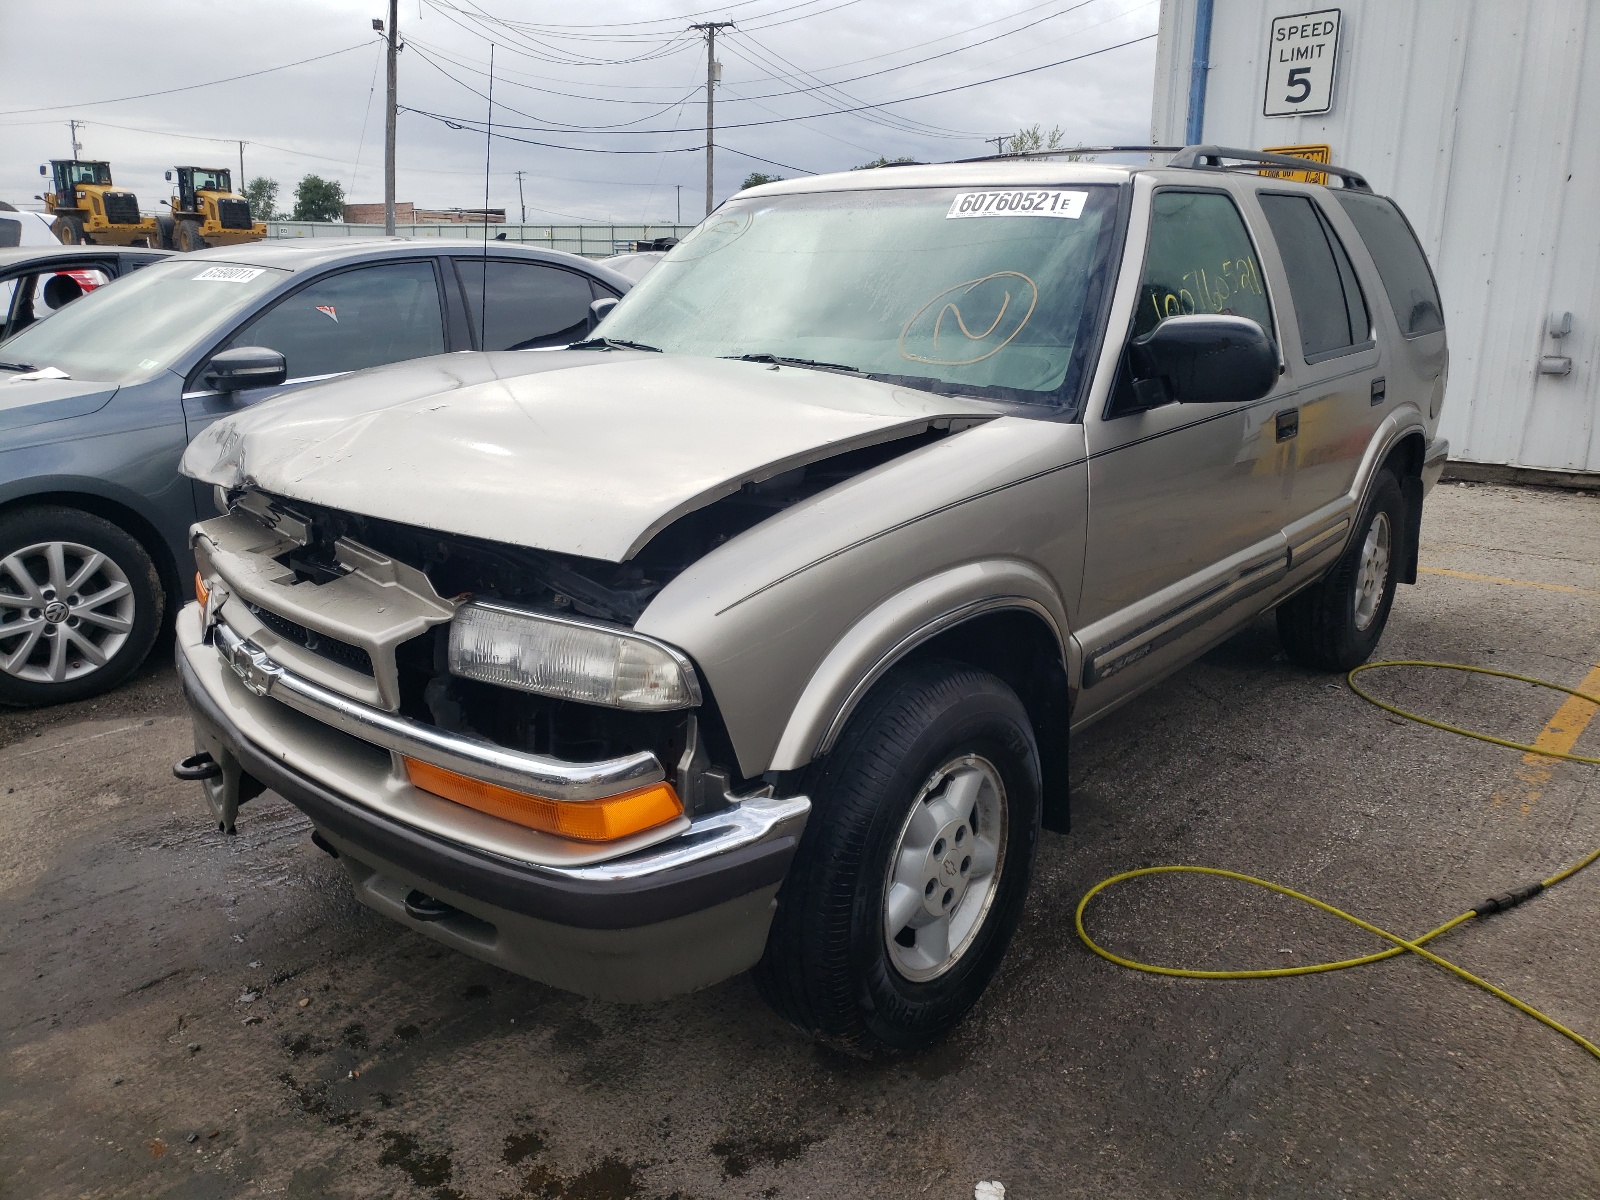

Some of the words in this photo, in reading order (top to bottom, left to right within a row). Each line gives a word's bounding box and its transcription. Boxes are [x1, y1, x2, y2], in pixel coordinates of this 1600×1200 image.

[1276, 21, 1335, 42] SPEED
[1279, 43, 1326, 63] LIMIT
[1284, 66, 1312, 104] 5
